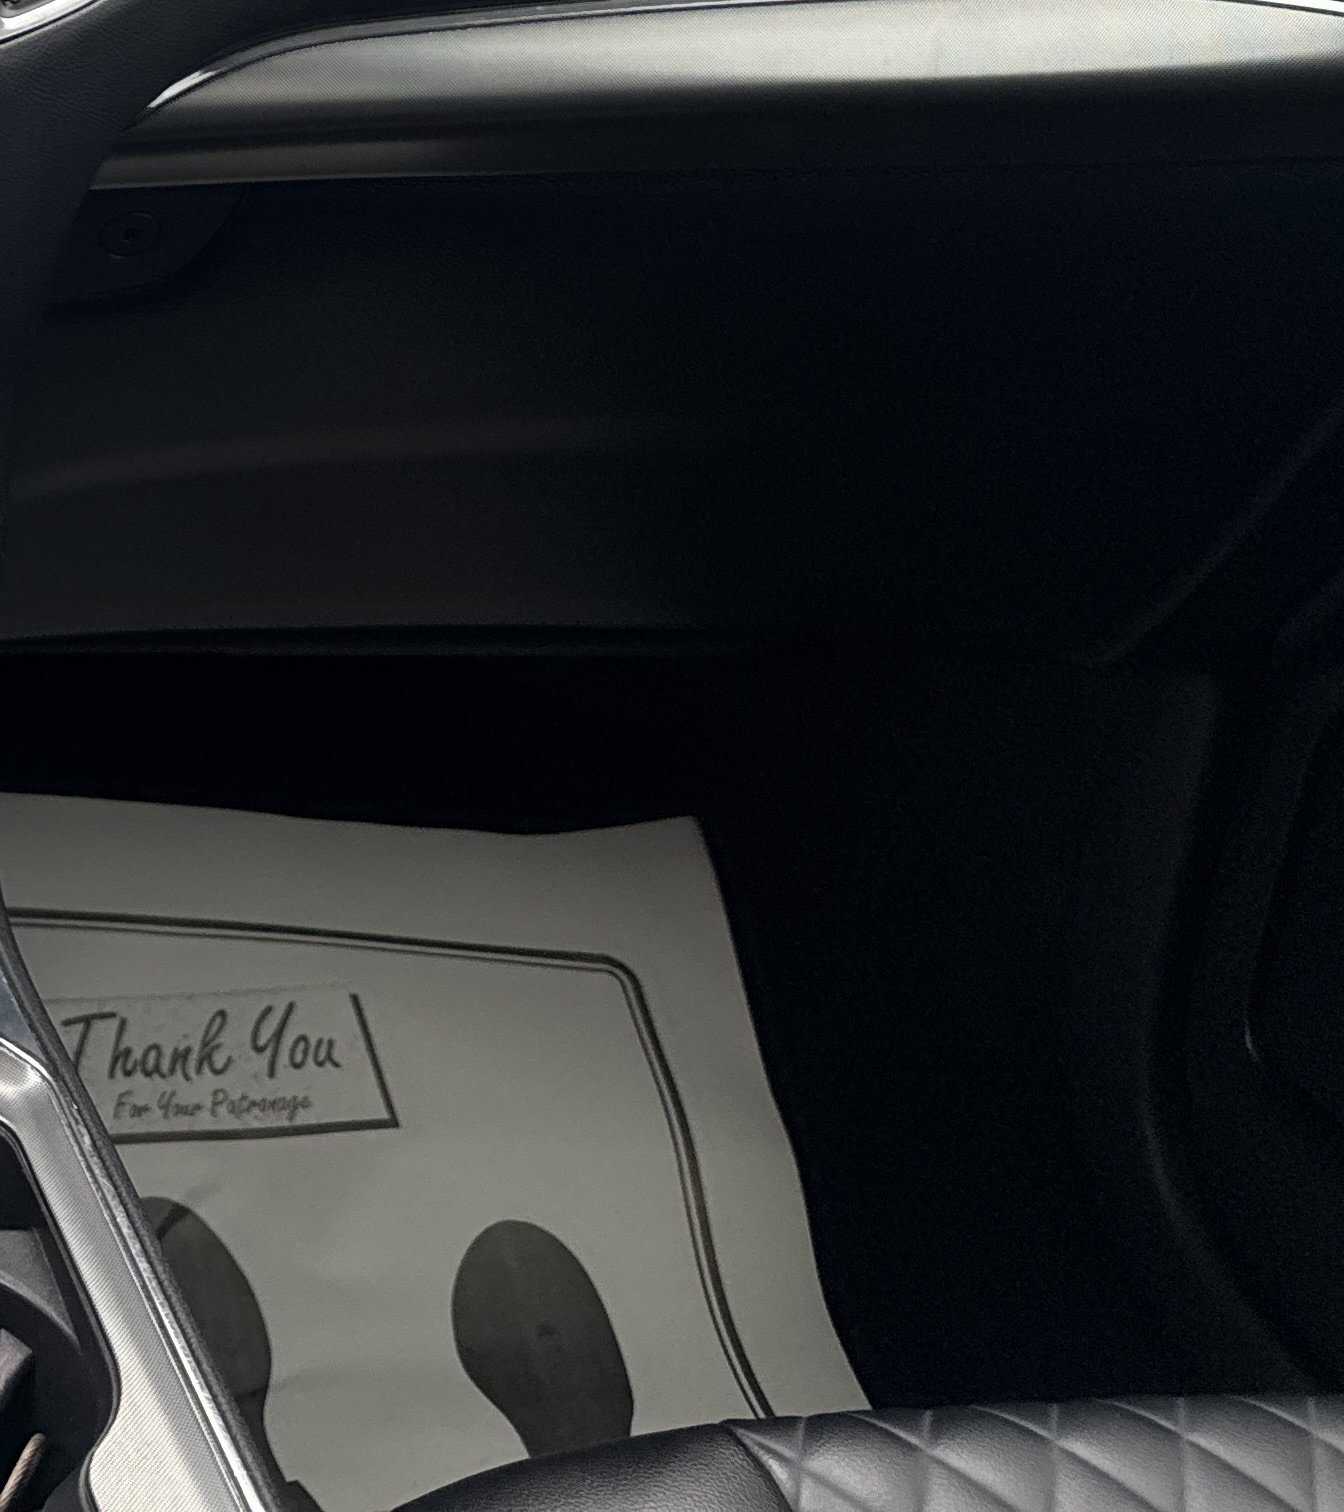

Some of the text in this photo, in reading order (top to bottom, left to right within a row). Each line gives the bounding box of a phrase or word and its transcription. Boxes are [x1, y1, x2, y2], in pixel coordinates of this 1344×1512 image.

[61, 1000, 342, 1081] Thank You
[112, 1087, 312, 1120] For Your Patronage
